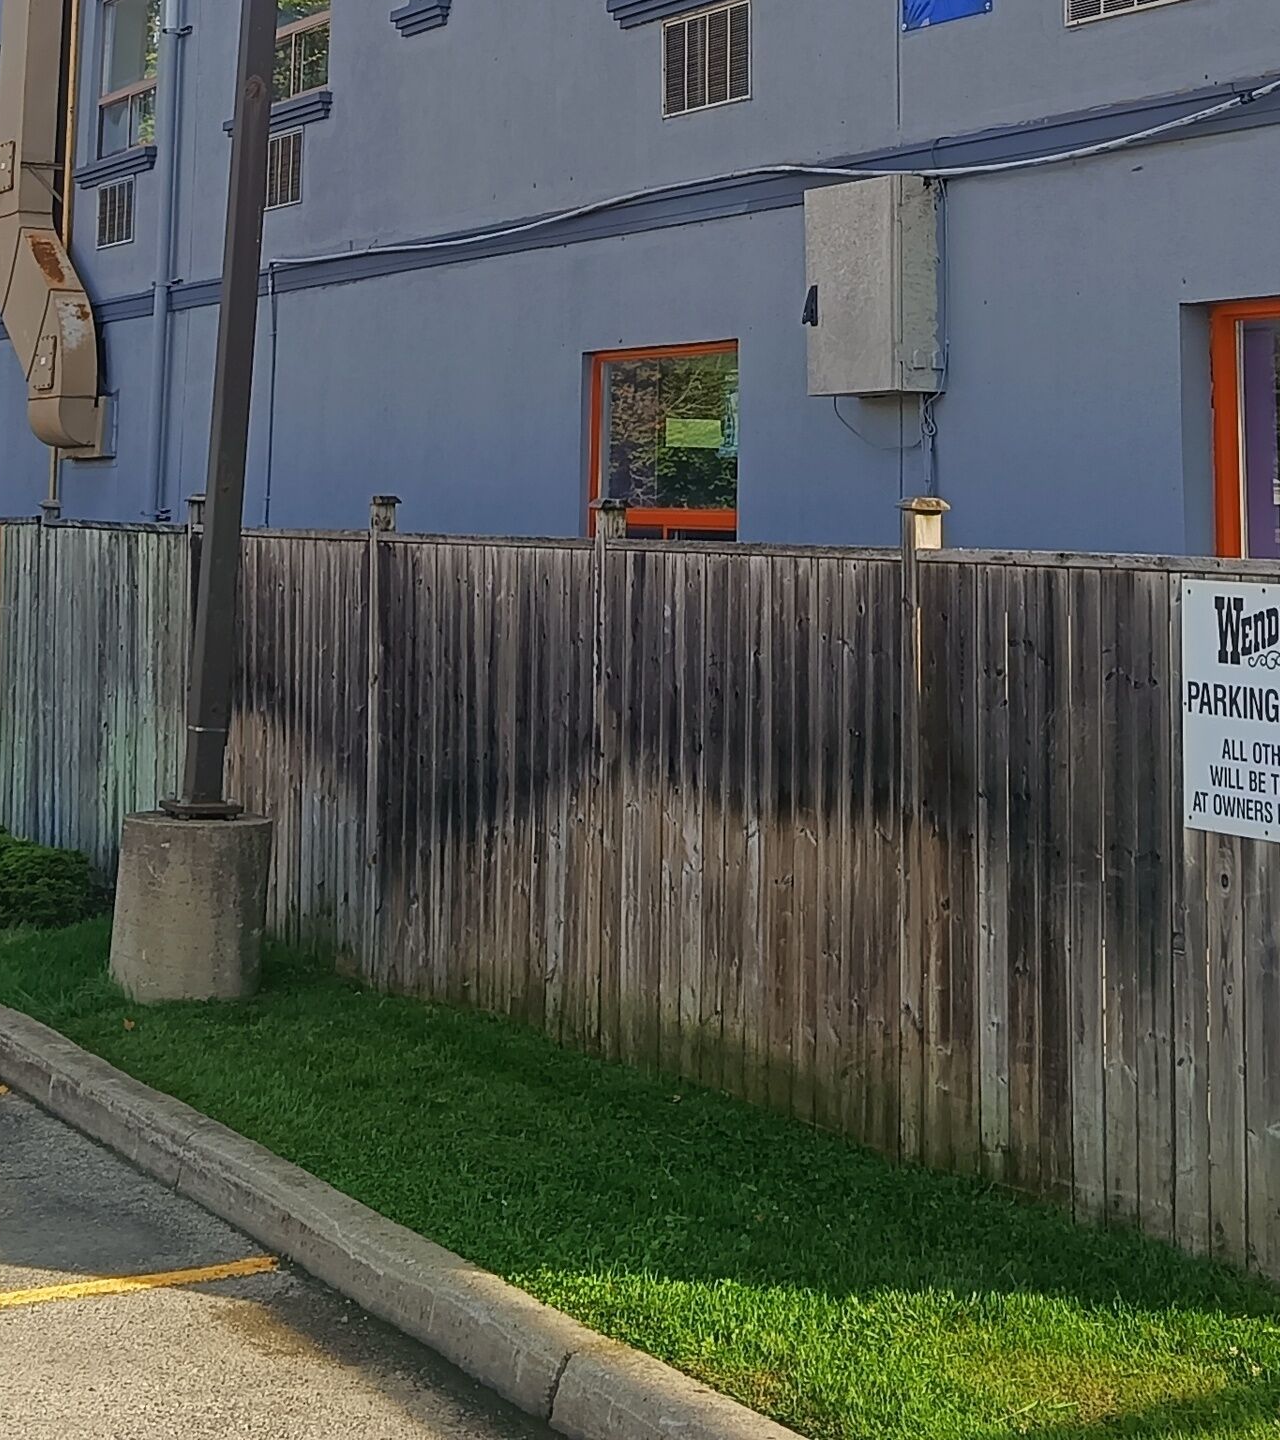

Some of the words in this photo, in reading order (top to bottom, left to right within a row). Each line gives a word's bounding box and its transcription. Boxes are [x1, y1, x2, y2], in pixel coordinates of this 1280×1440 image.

[1188, 681, 1279, 722] PARKING
[1222, 739, 1247, 762] ALL
[1210, 765, 1244, 790] WILL
[1249, 771, 1266, 793] BE
[1193, 791, 1208, 813] AT
[1214, 794, 1273, 823] OWNERS
